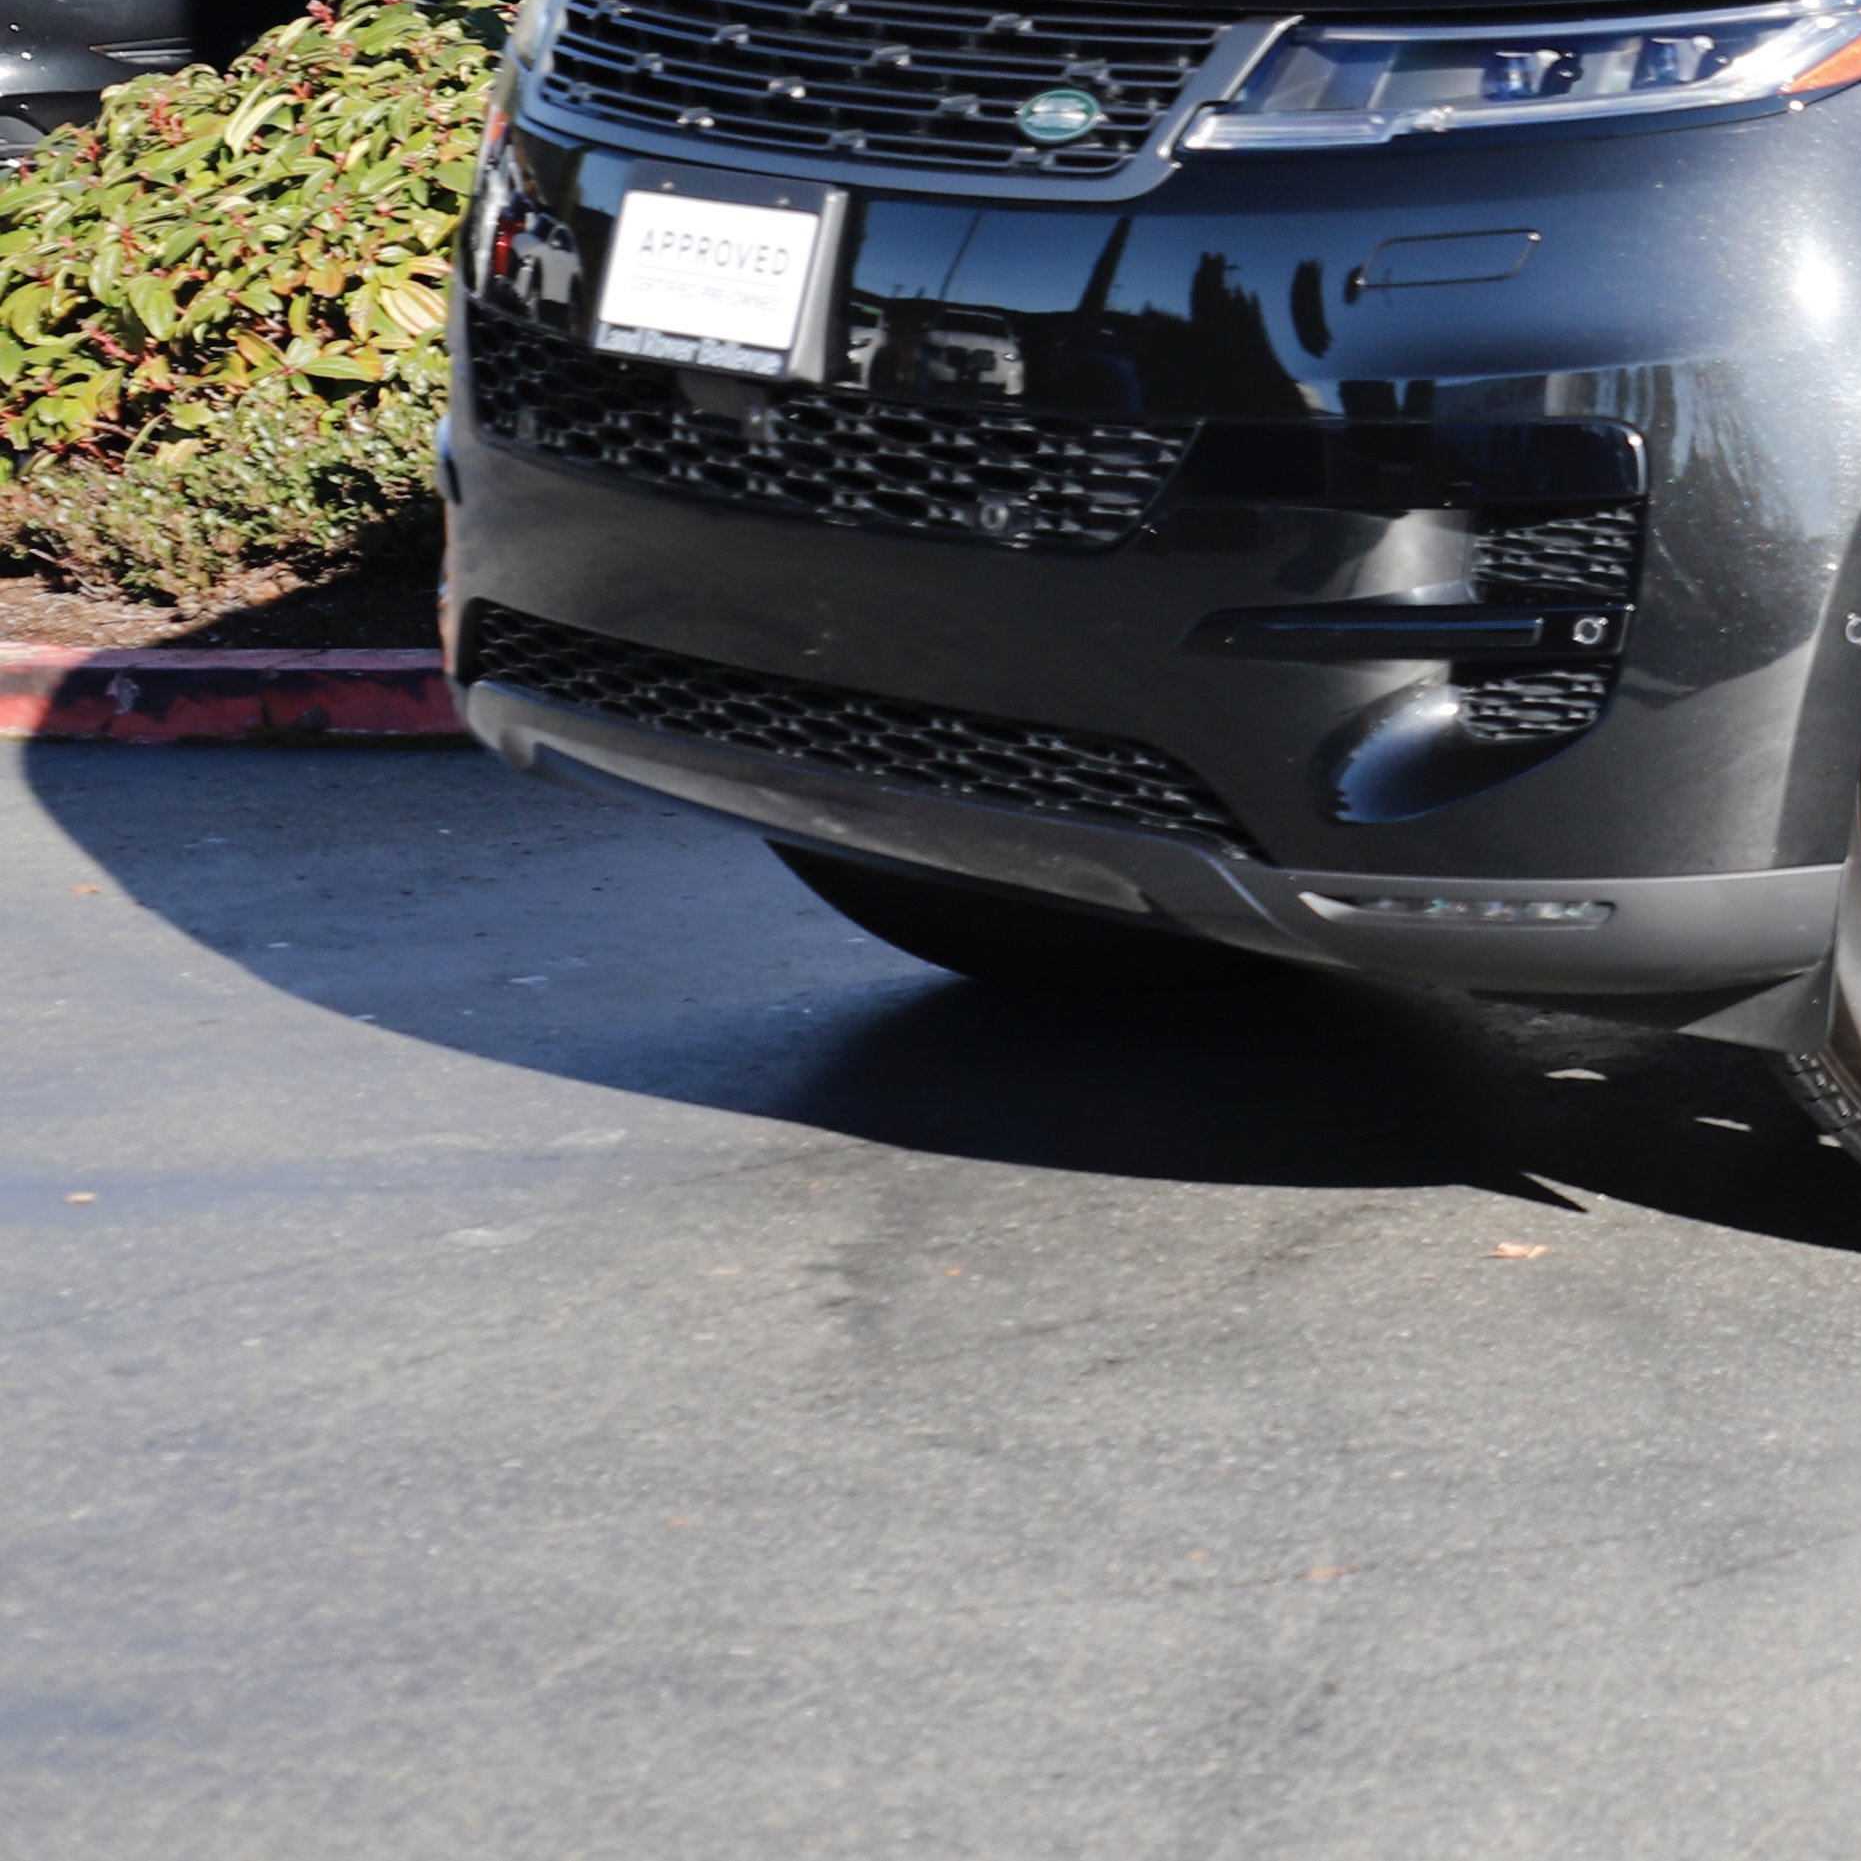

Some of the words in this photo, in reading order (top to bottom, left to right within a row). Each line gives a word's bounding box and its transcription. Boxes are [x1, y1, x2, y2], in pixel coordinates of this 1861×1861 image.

[640, 229, 790, 275] APPROVED
[594, 322, 642, 354] Land
[640, 326, 698, 363] Rover
[695, 336, 785, 376] Bellevue
